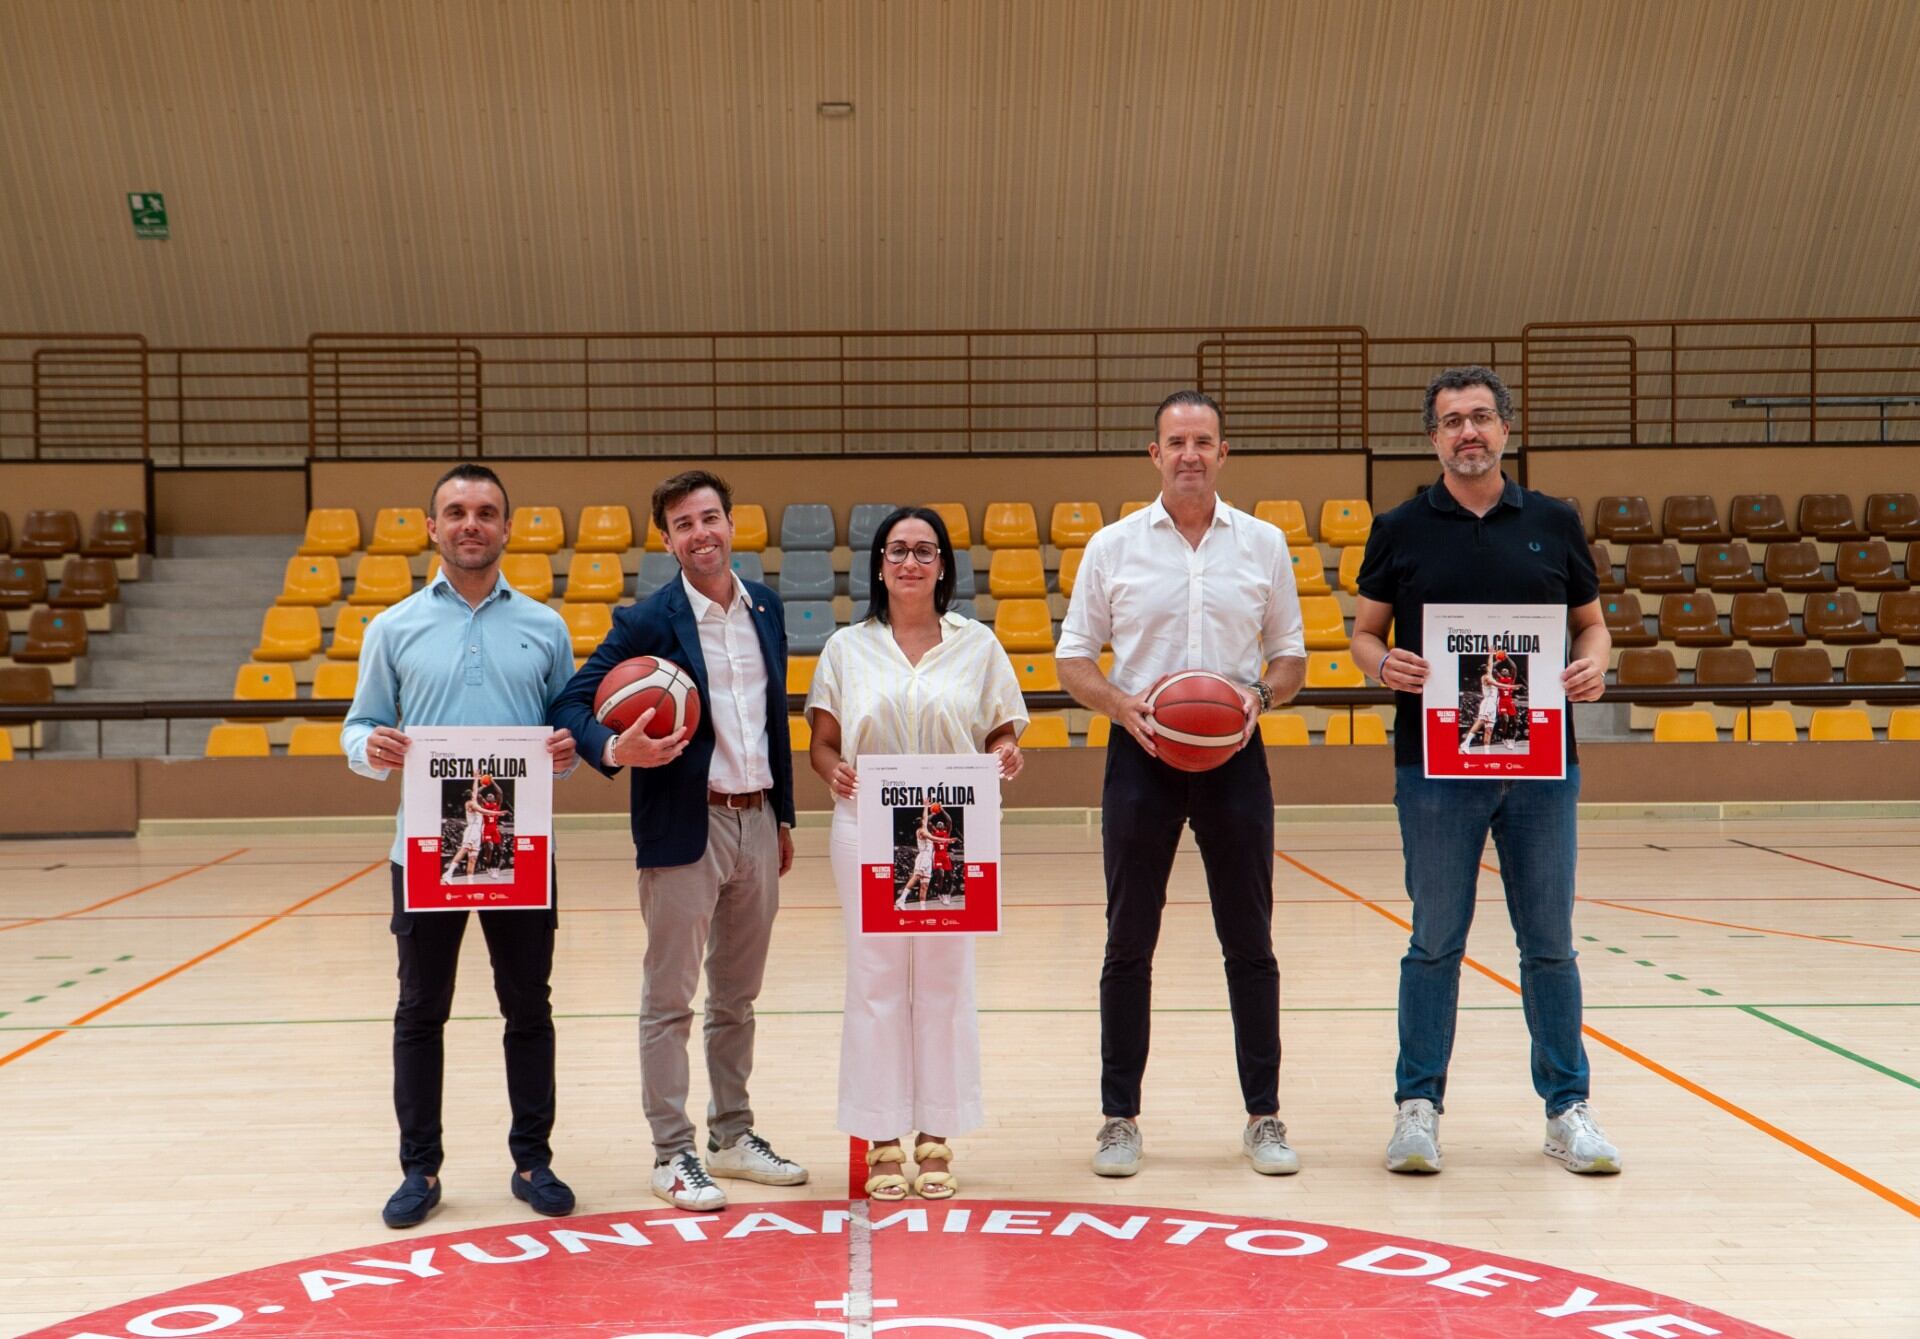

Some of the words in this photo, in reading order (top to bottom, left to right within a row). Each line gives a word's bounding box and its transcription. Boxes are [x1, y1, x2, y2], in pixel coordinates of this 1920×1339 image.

[1447, 633, 1489, 653] COSTA
[1492, 629, 1541, 653] CÁLIDA
[429, 757, 474, 778] COSTA
[477, 753, 527, 778] CÁLIDA
[881, 786, 924, 806] COSTA
[927, 781, 975, 805] CÁLIDA
[298, 1208, 1329, 1302] AYUNTAMIENTO
[1336, 1245, 1543, 1297] DE
